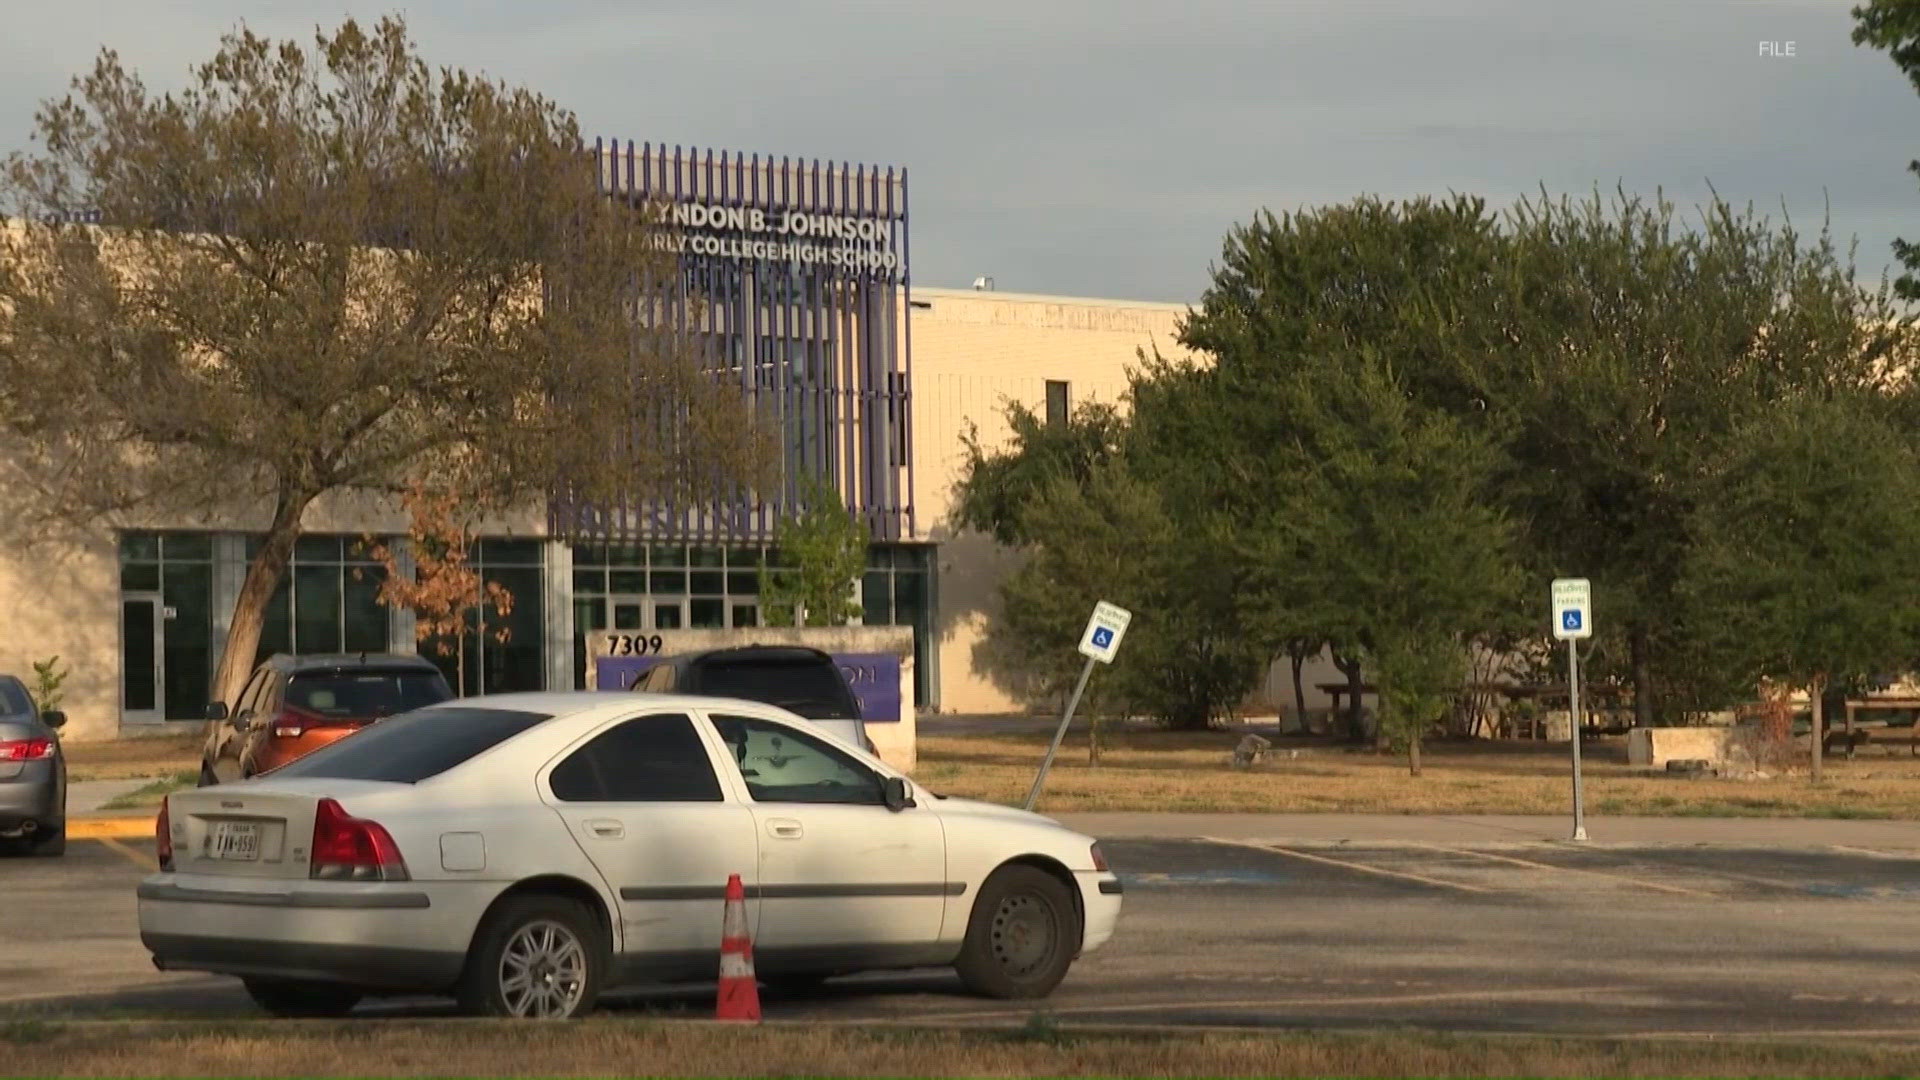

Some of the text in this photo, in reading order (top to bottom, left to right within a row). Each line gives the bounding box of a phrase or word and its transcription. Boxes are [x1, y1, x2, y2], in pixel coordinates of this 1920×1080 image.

[750, 208, 772, 233] B.
[777, 211, 892, 242] JOHNSON
[691, 235, 777, 261] COLLEGE
[781, 243, 828, 264] HIGH
[607, 635, 662, 656] 7309
